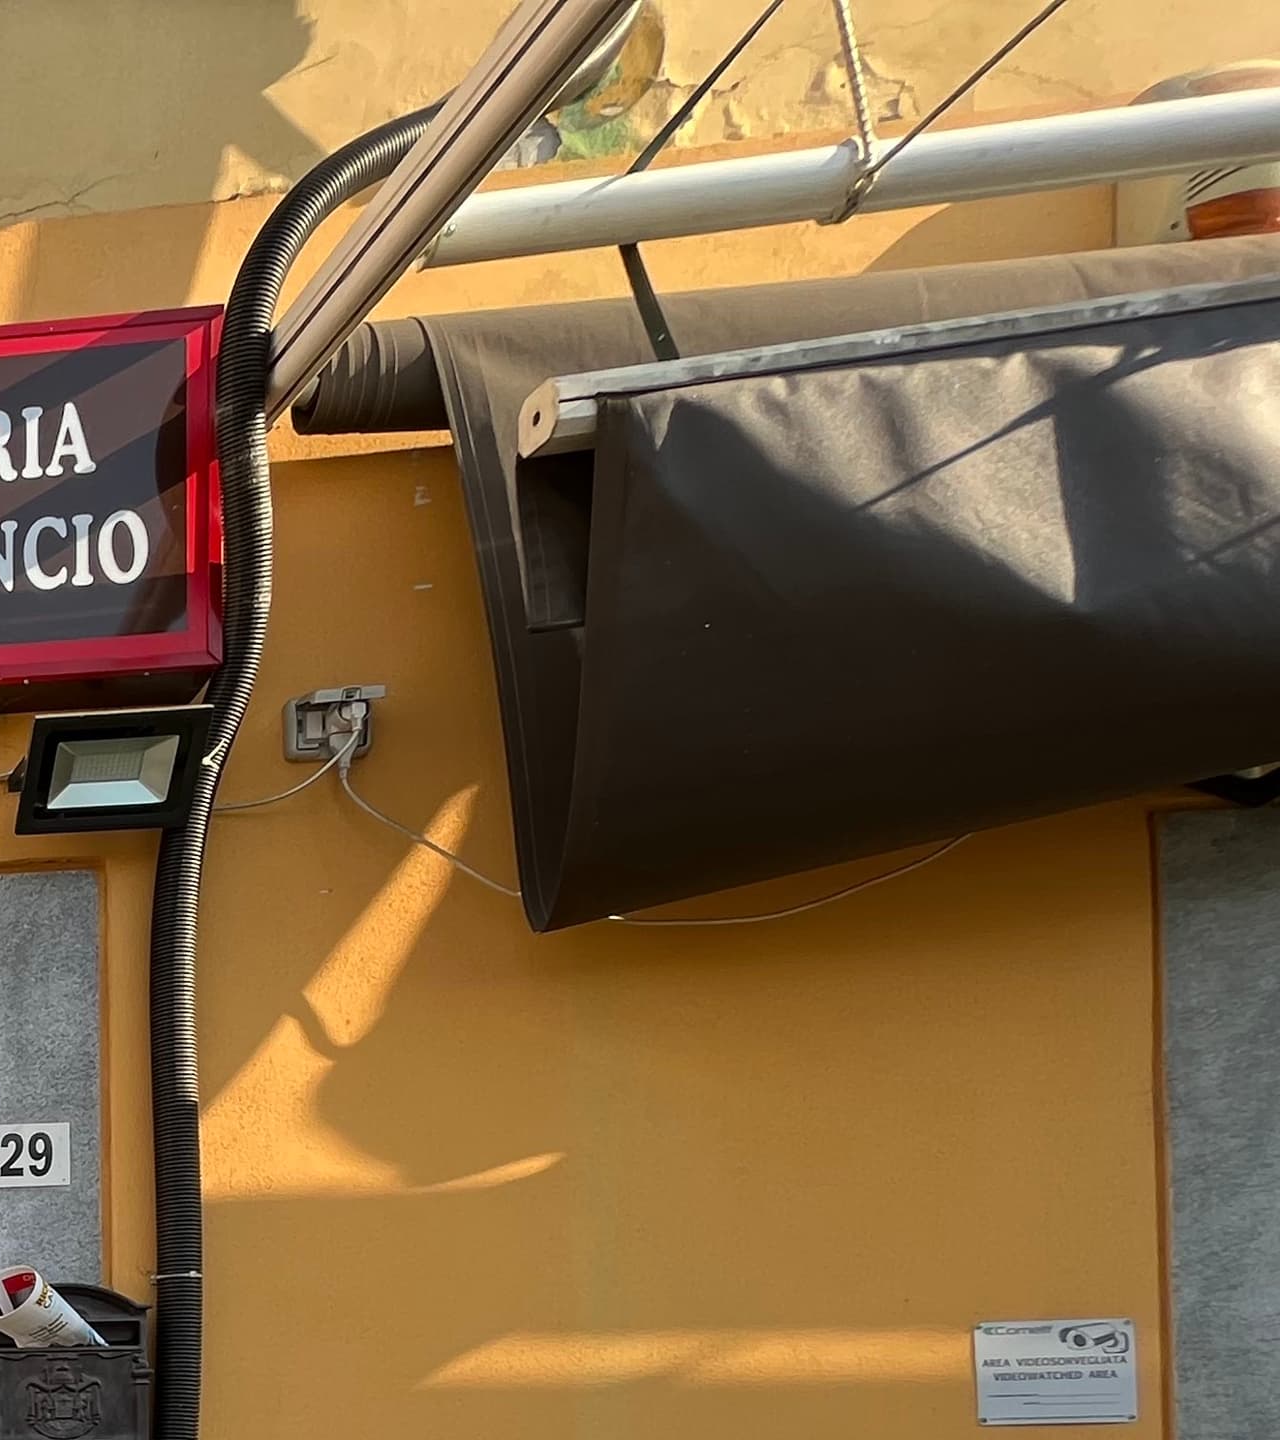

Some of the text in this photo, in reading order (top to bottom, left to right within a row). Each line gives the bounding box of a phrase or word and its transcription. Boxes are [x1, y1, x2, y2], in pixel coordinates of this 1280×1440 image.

[0, 1132, 53, 1177] 29
[982, 1358, 1011, 1368] AREA
[1088, 1370, 1118, 1379] AREA
